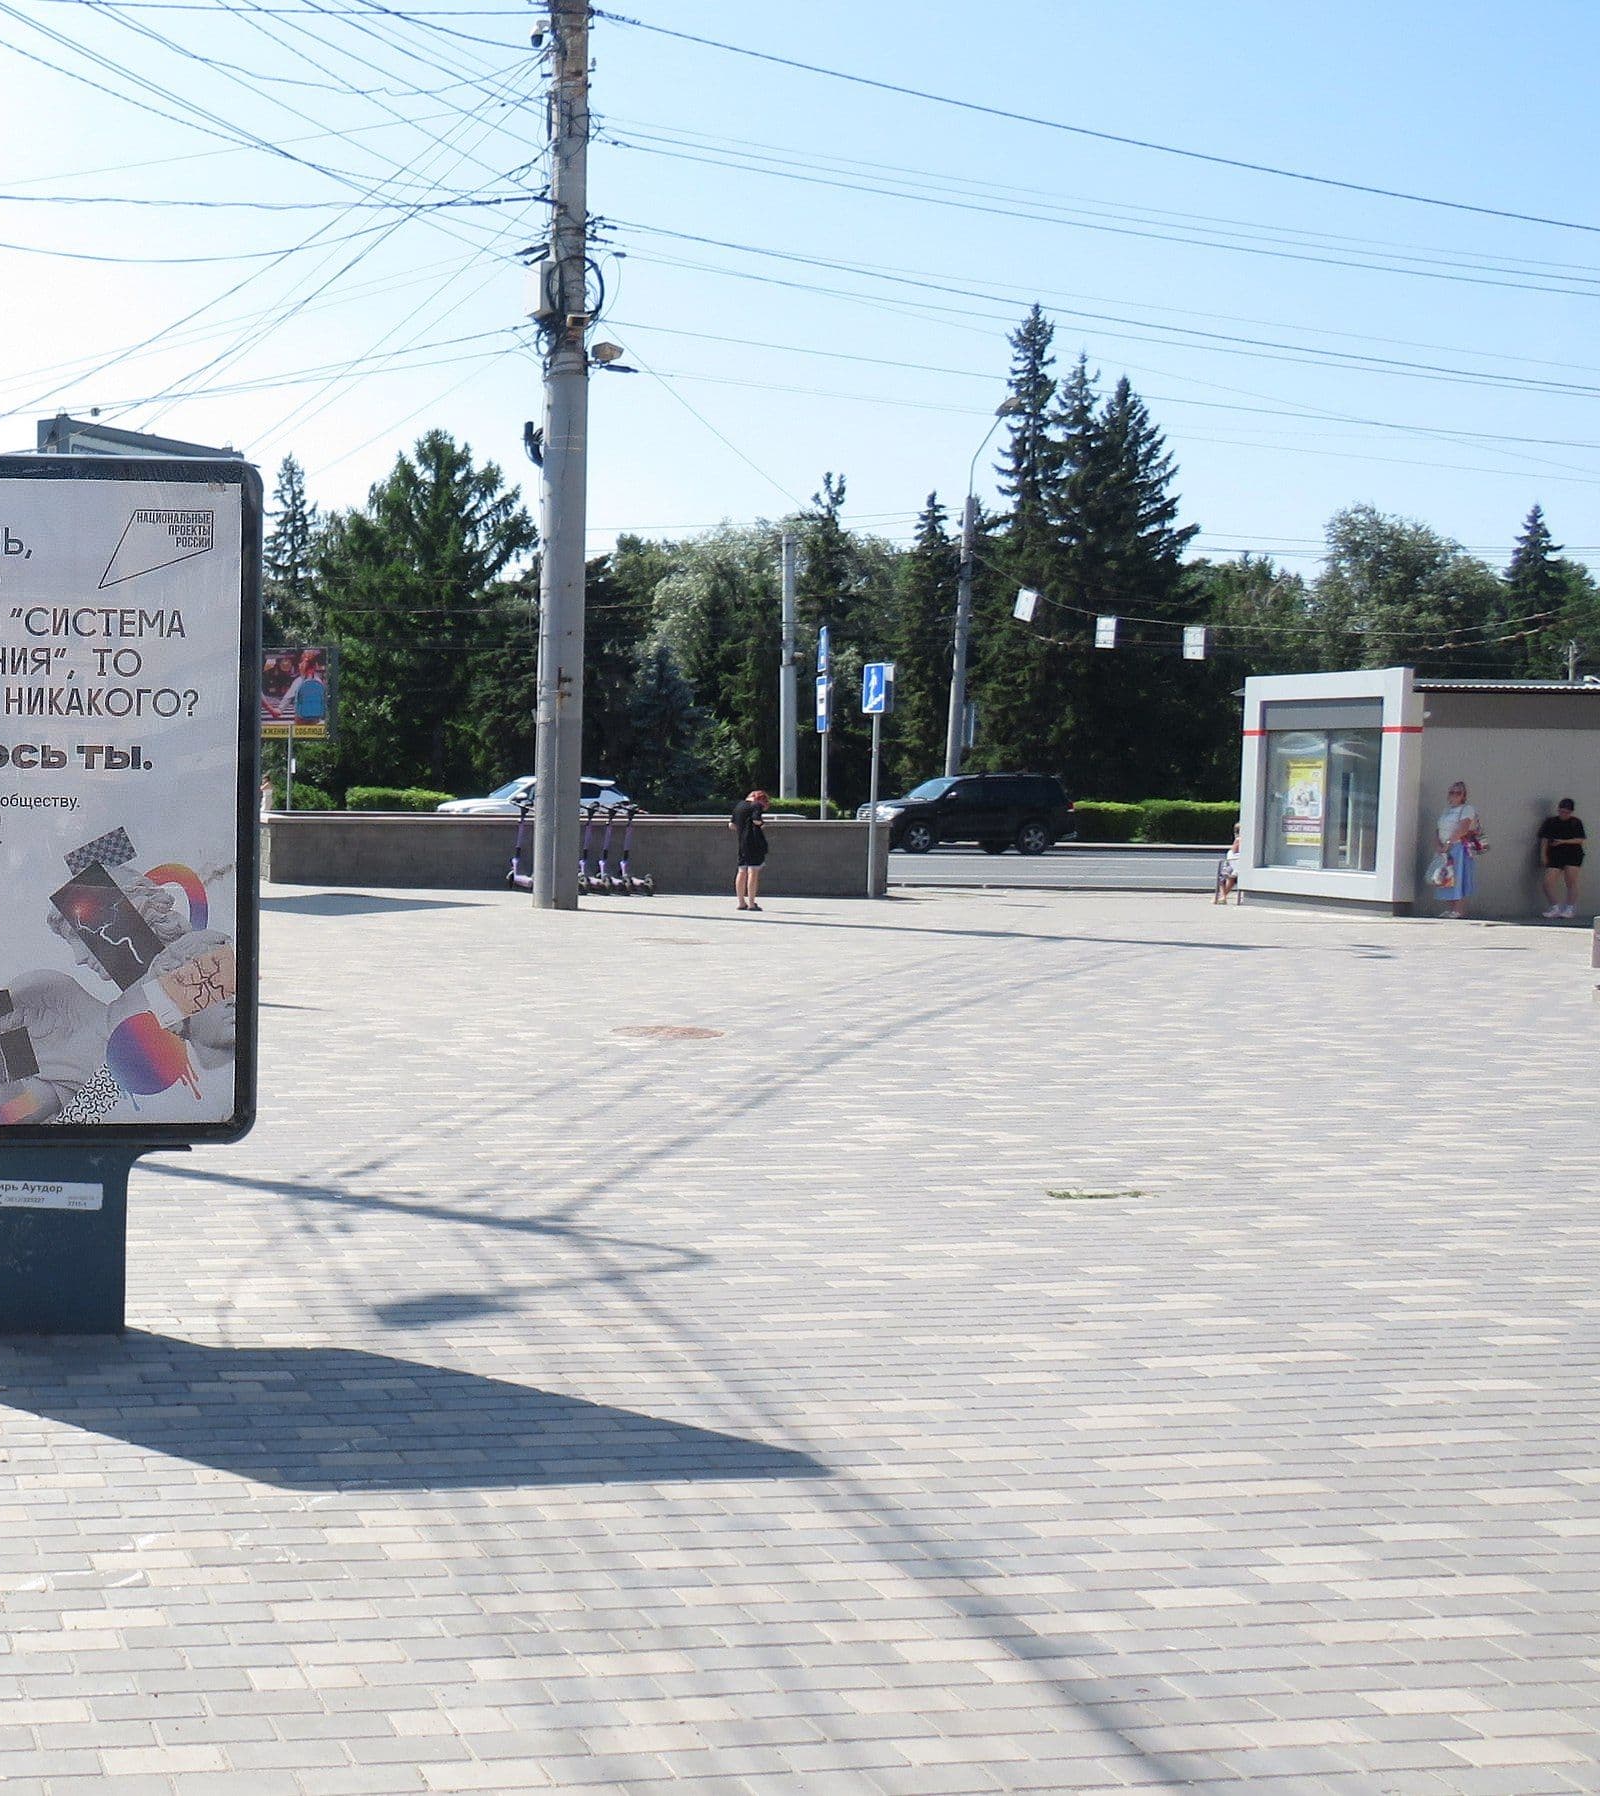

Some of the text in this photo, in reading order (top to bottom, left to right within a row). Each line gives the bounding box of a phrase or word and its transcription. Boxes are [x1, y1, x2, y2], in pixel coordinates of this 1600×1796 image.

[137, 511, 211, 525] НАЦИОНАЛЬНЫЕ
[168, 525, 211, 536] ПРОЕКТЫ
[176, 536, 211, 548] РОССИИ
[10, 606, 186, 638] "СИСТЕМА
[92, 648, 143, 678] ТО
[5, 686, 200, 717] НИКАКОГО?
[76, 745, 153, 770] ты.
[21, 1182, 64, 1194] Аутдор
